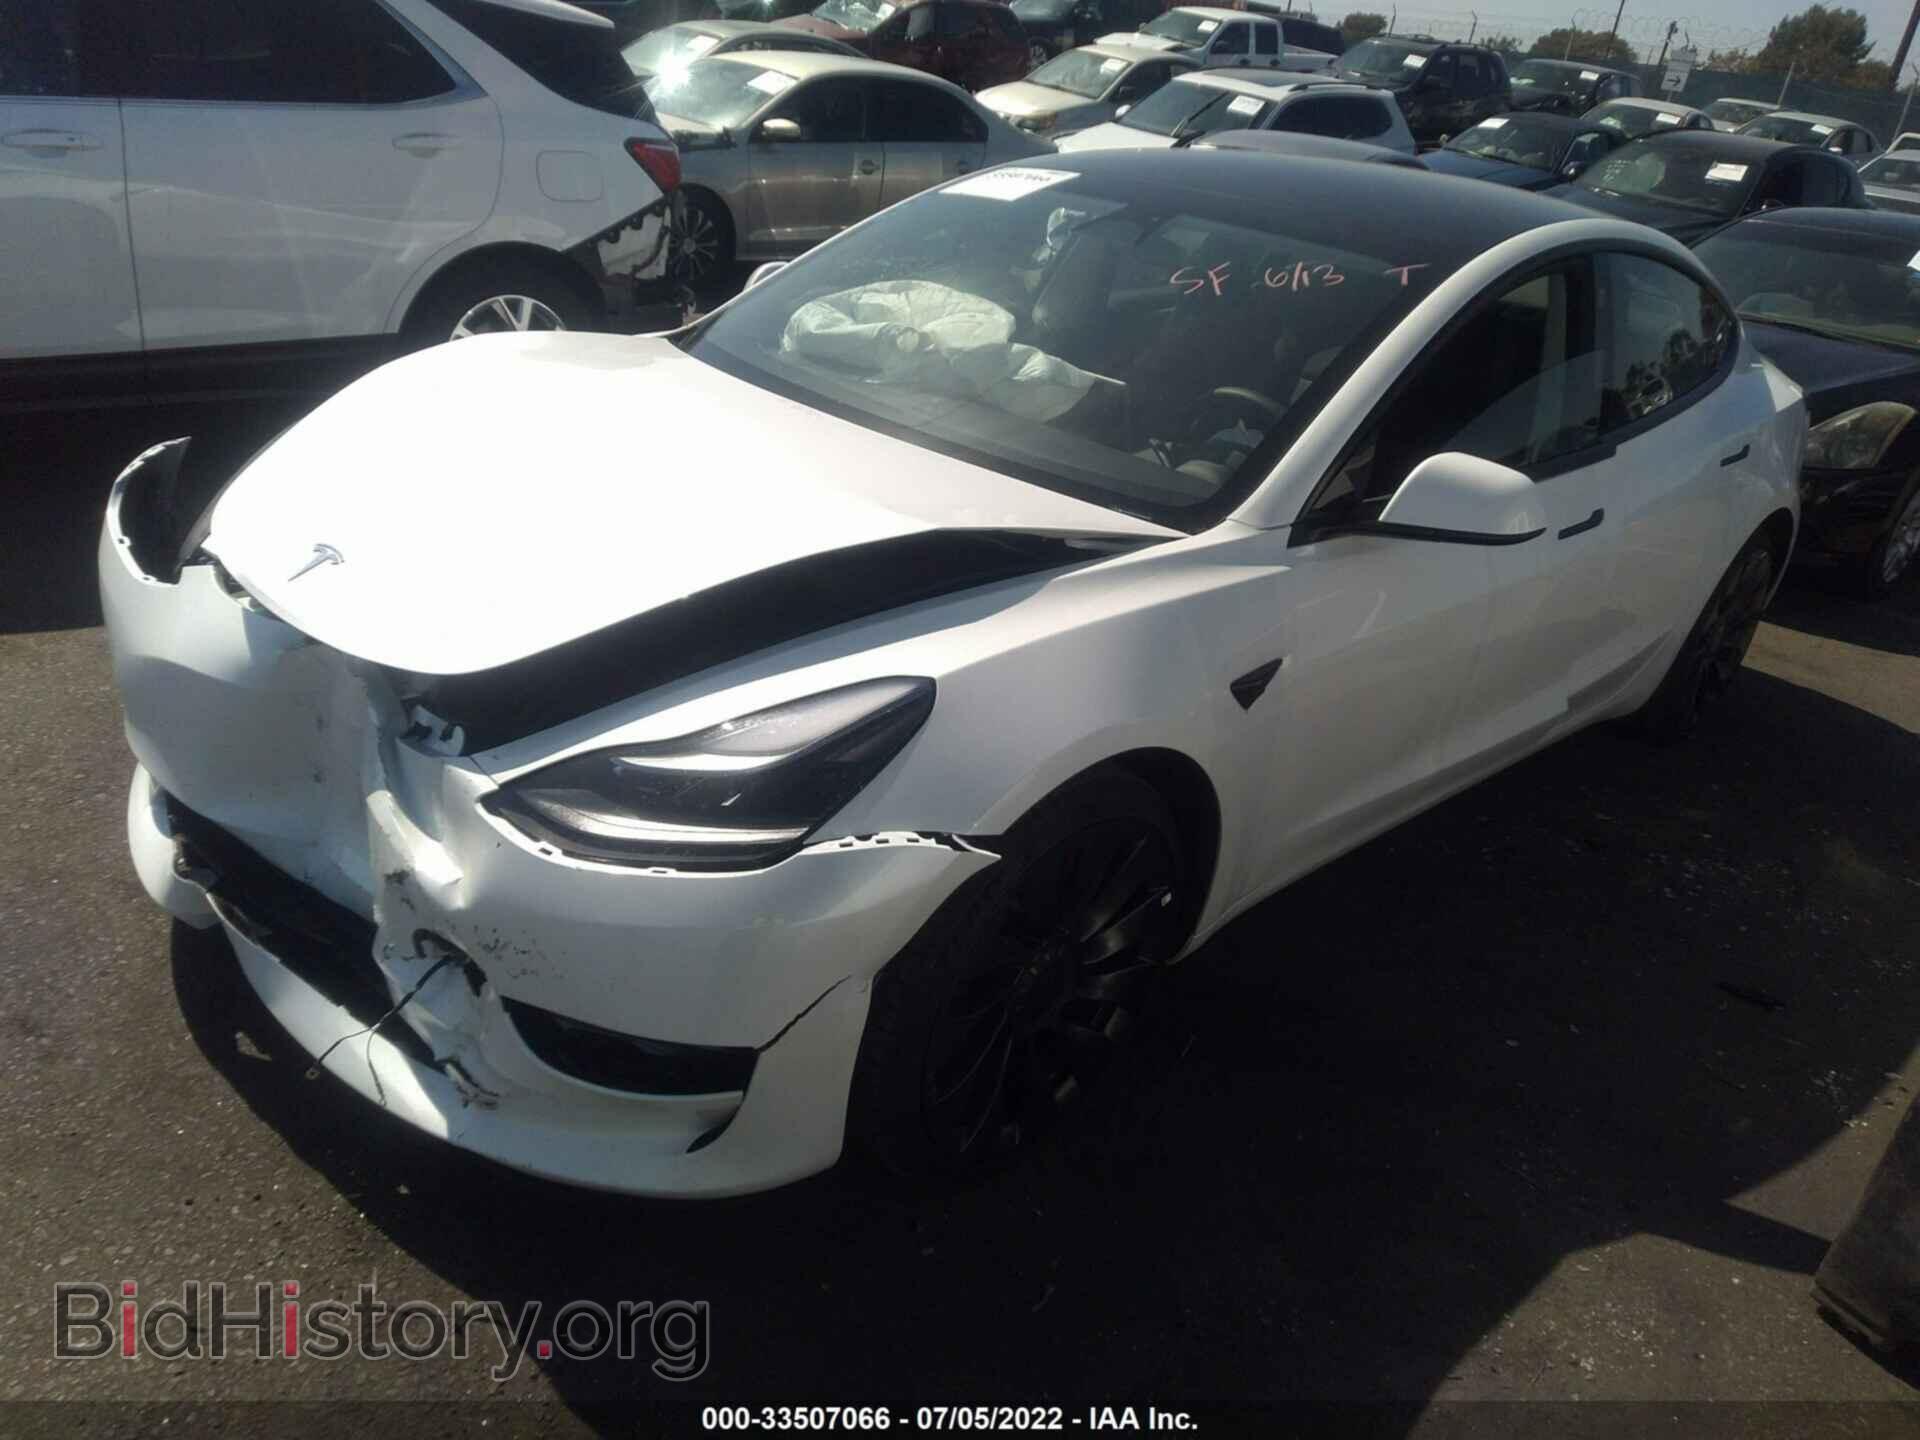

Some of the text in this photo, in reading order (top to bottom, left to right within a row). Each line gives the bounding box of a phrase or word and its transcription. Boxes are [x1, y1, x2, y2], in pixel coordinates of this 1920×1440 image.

[1170, 261, 1430, 296] SF 6/13 T
